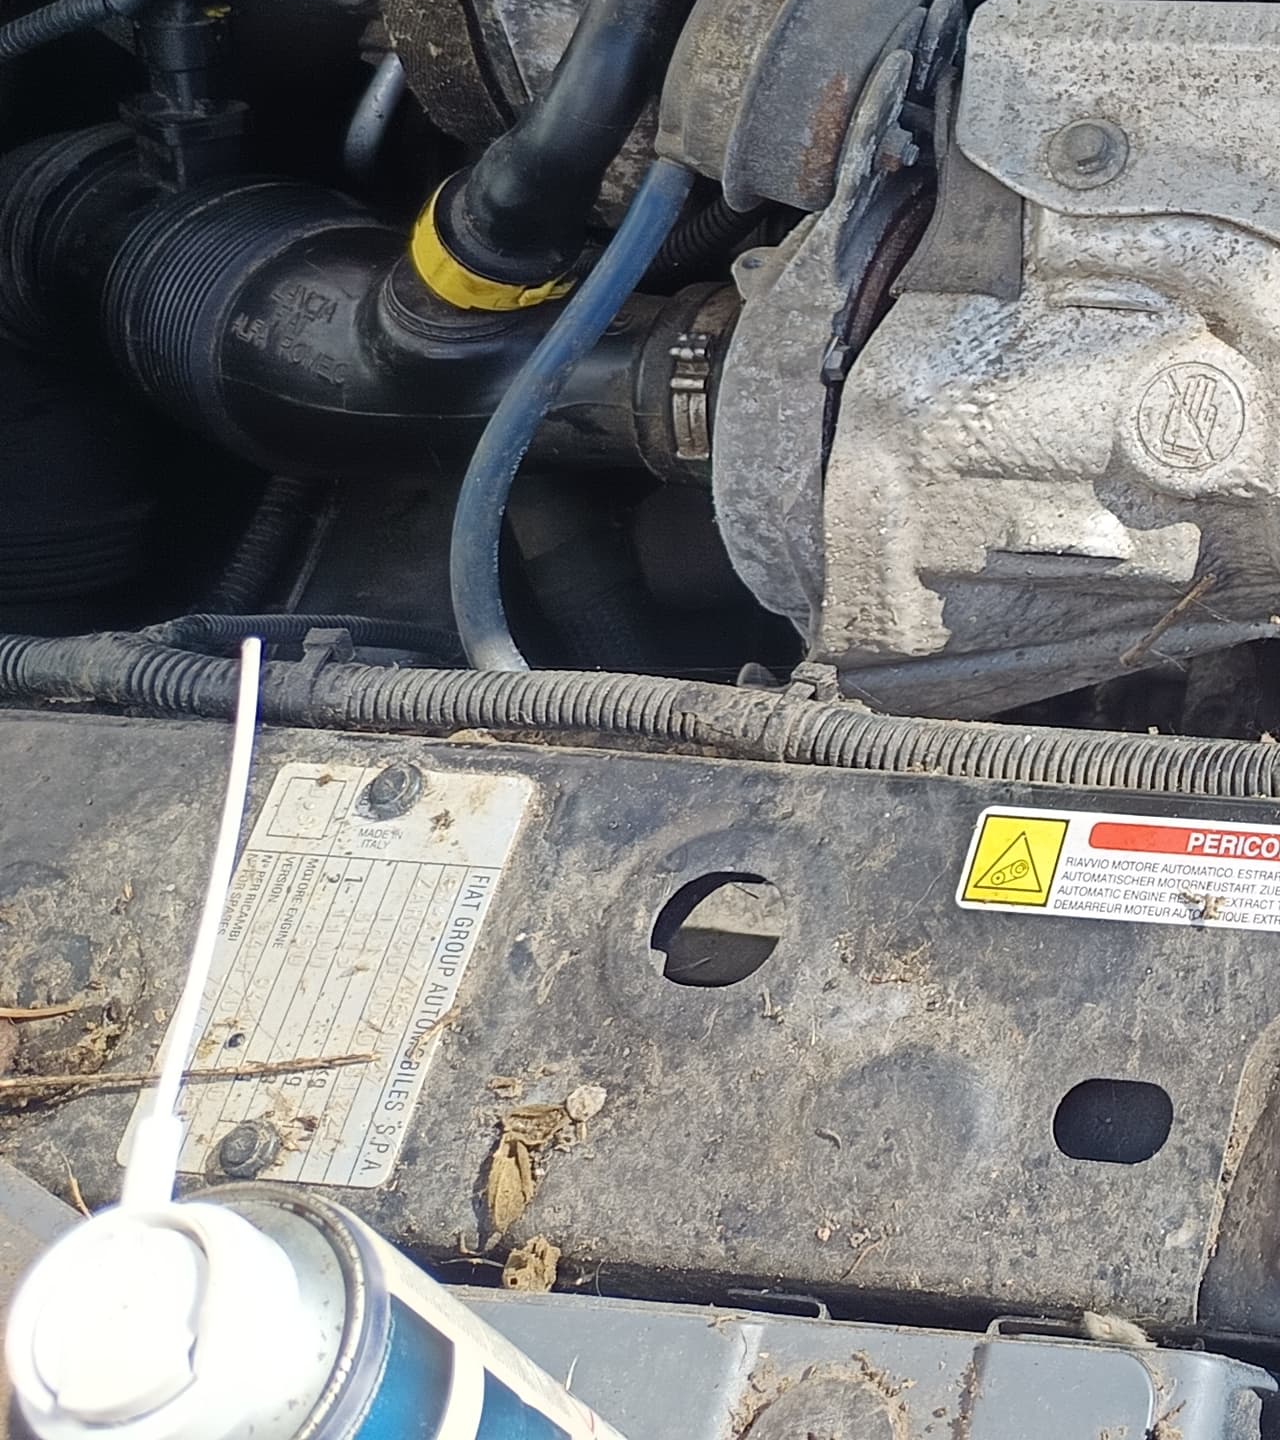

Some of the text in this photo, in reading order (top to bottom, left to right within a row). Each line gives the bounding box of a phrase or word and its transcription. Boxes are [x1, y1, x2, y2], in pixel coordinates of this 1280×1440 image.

[357, 828, 389, 840] MADE
[361, 839, 391, 850] ITALY
[1065, 856, 1109, 870] RIAVVIO
[1112, 860, 1159, 873] MOTORE
[267, 855, 297, 904] VERSION
[1061, 871, 1155, 887] AUTOMATISCHER
[462, 874, 490, 911] FIAT
[1057, 885, 1121, 899] AUTOMATIC
[1123, 890, 1169, 902] ENGINE
[1225, 898, 1274, 910] EXTRACT
[227, 891, 257, 942] RICAMBI
[1053, 898, 1122, 913] DEMARREUR
[1124, 903, 1170, 917] MOTEUR
[438, 917, 474, 977] GROUP
